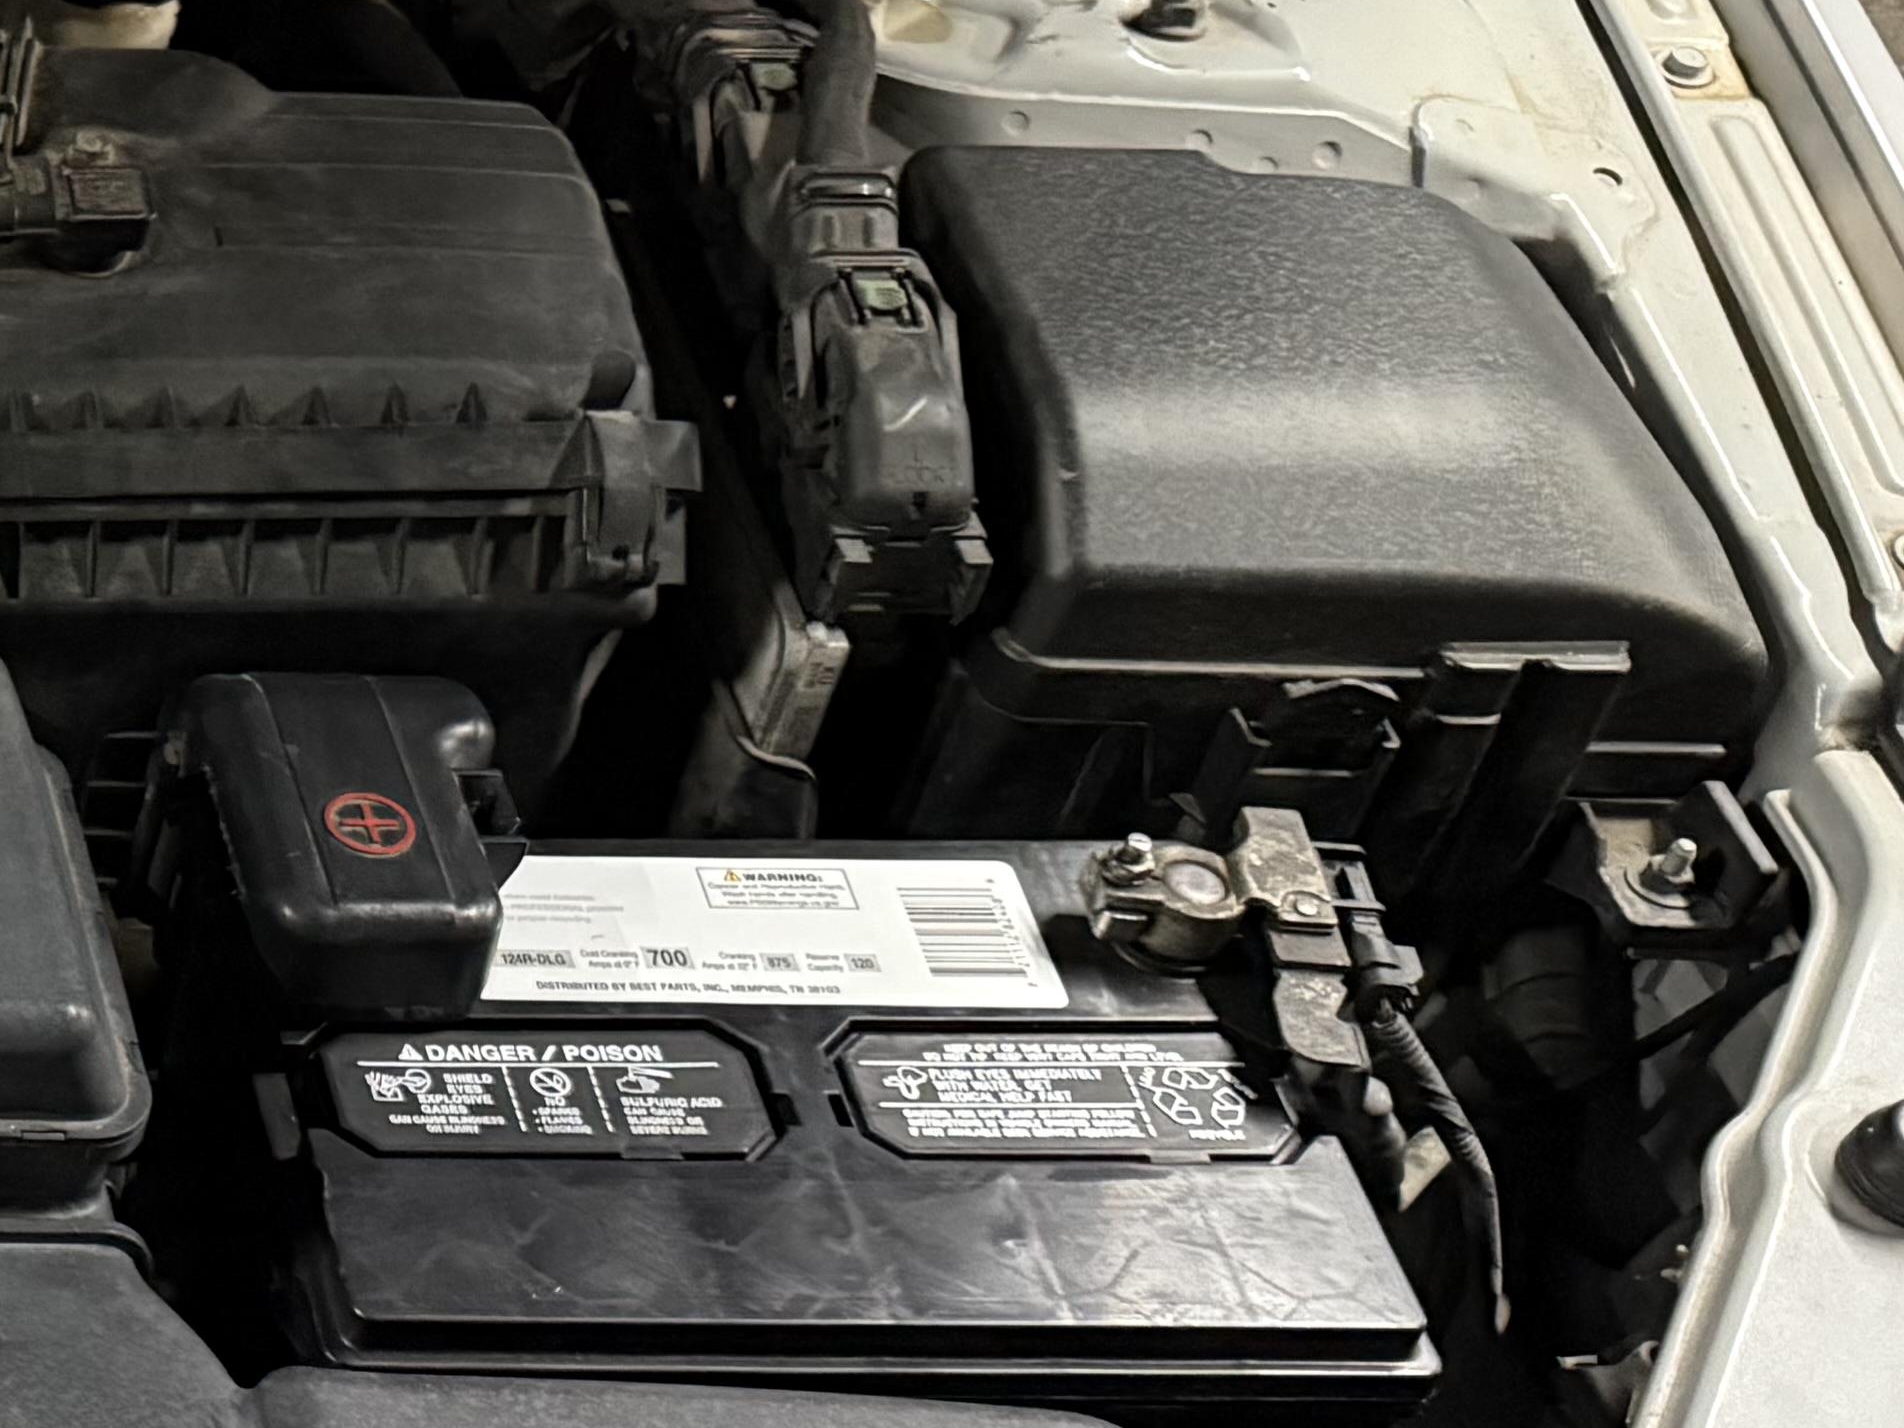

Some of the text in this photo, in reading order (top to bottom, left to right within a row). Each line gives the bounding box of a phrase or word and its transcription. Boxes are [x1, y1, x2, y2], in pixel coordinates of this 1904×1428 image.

[646, 949, 688, 967] 700
[536, 980, 609, 991] DISTRIBUTED
[611, 981, 626, 991] BY
[629, 981, 657, 991] BEST
[425, 1044, 538, 1062] DANGER
[562, 1044, 664, 1062] POISON
[443, 1073, 492, 1084] SHIELD
[927, 1068, 1102, 1080] FLUSH EYES IMMEDIATELY
[446, 1084, 483, 1094] EYES
[932, 1080, 969, 1091] WITH
[418, 1094, 495, 1105] EXPLOSIVE
[544, 1097, 566, 1106] NO
[937, 1090, 1073, 1103] MEDICAL HELP FAST
[620, 1097, 723, 1108] SULFURIC ACID
[421, 1104, 469, 1114] GASES
